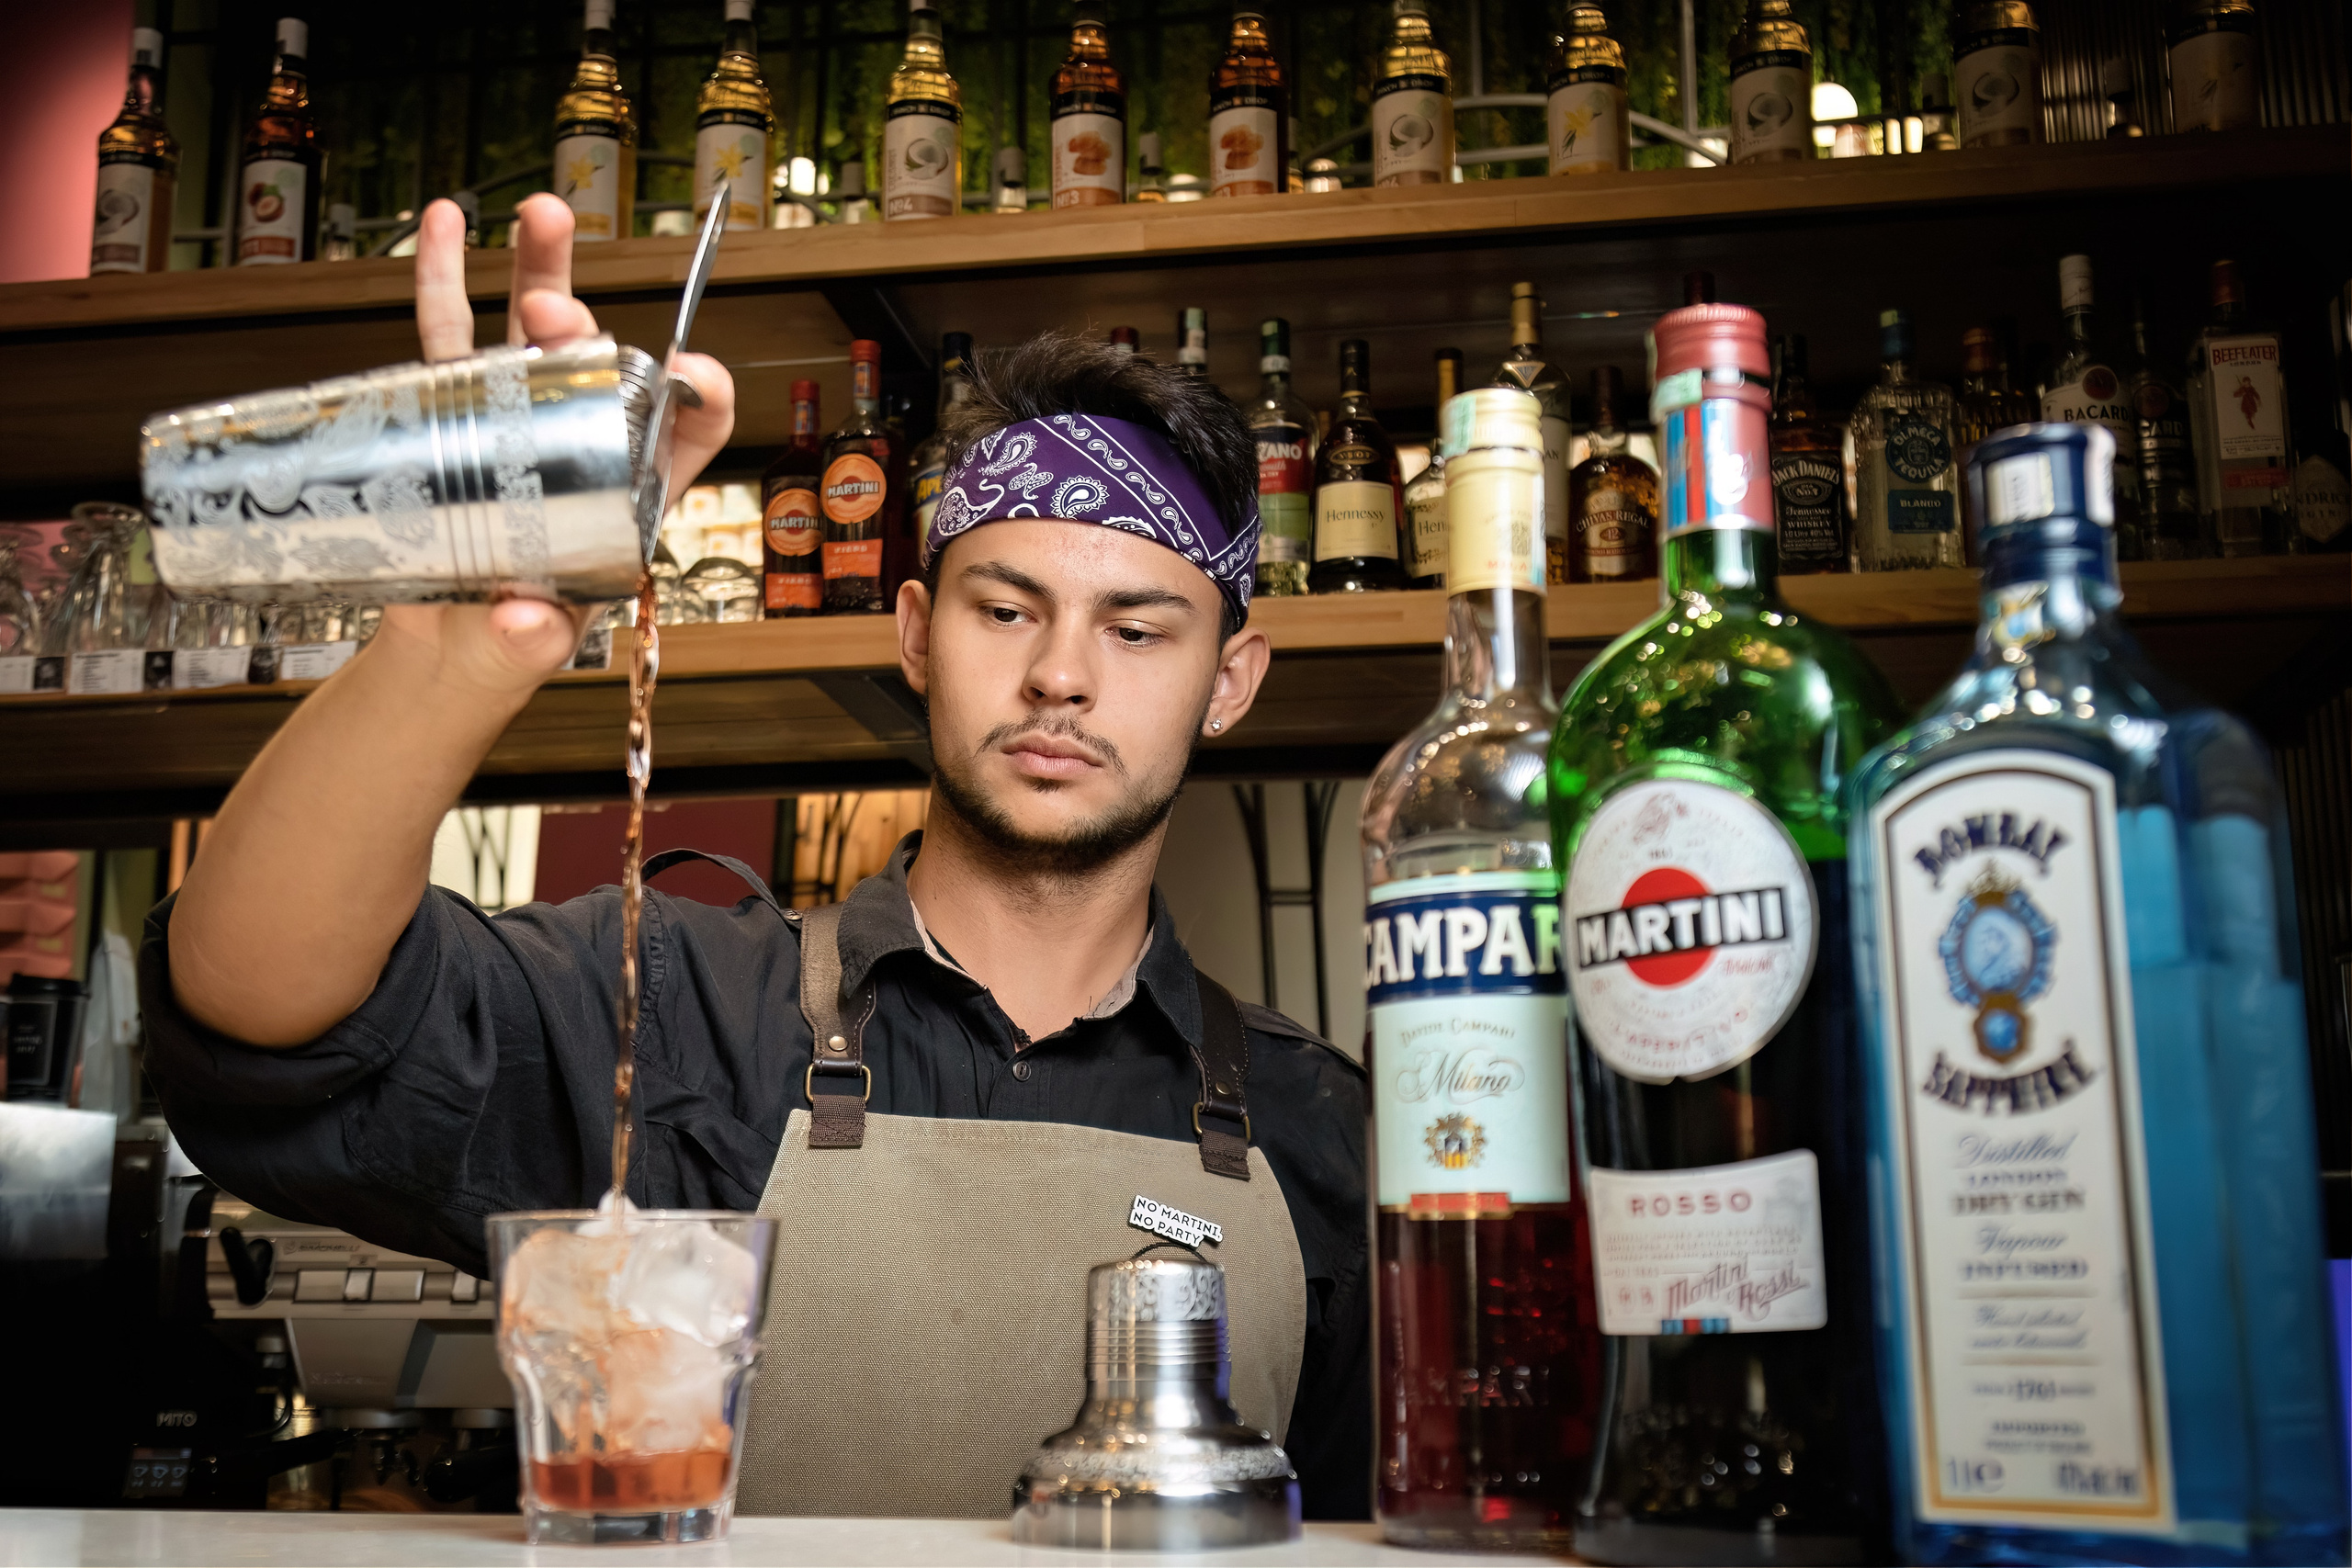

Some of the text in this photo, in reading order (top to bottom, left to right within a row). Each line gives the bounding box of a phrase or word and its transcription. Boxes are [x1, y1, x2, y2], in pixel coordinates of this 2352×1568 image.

[2211, 344, 2278, 366] BEEFEATER
[1893, 425, 1942, 446] OLMECA
[1772, 464, 1799, 487] JACK
[1894, 457, 1946, 479] TEQUILA
[827, 480, 880, 498] MARTINI
[1326, 508, 1385, 524] Hennessy
[1576, 509, 1649, 533] CHIVAS REGAL
[1787, 520, 1832, 528] WHISKEY
[1577, 888, 1784, 966] MARTINI
[1136, 1198, 1157, 1213] NO
[1630, 1190, 1752, 1218] ROSSO
[1133, 1213, 1201, 1244] NO PARTY
[1738, 1260, 1810, 1322] Rossi
